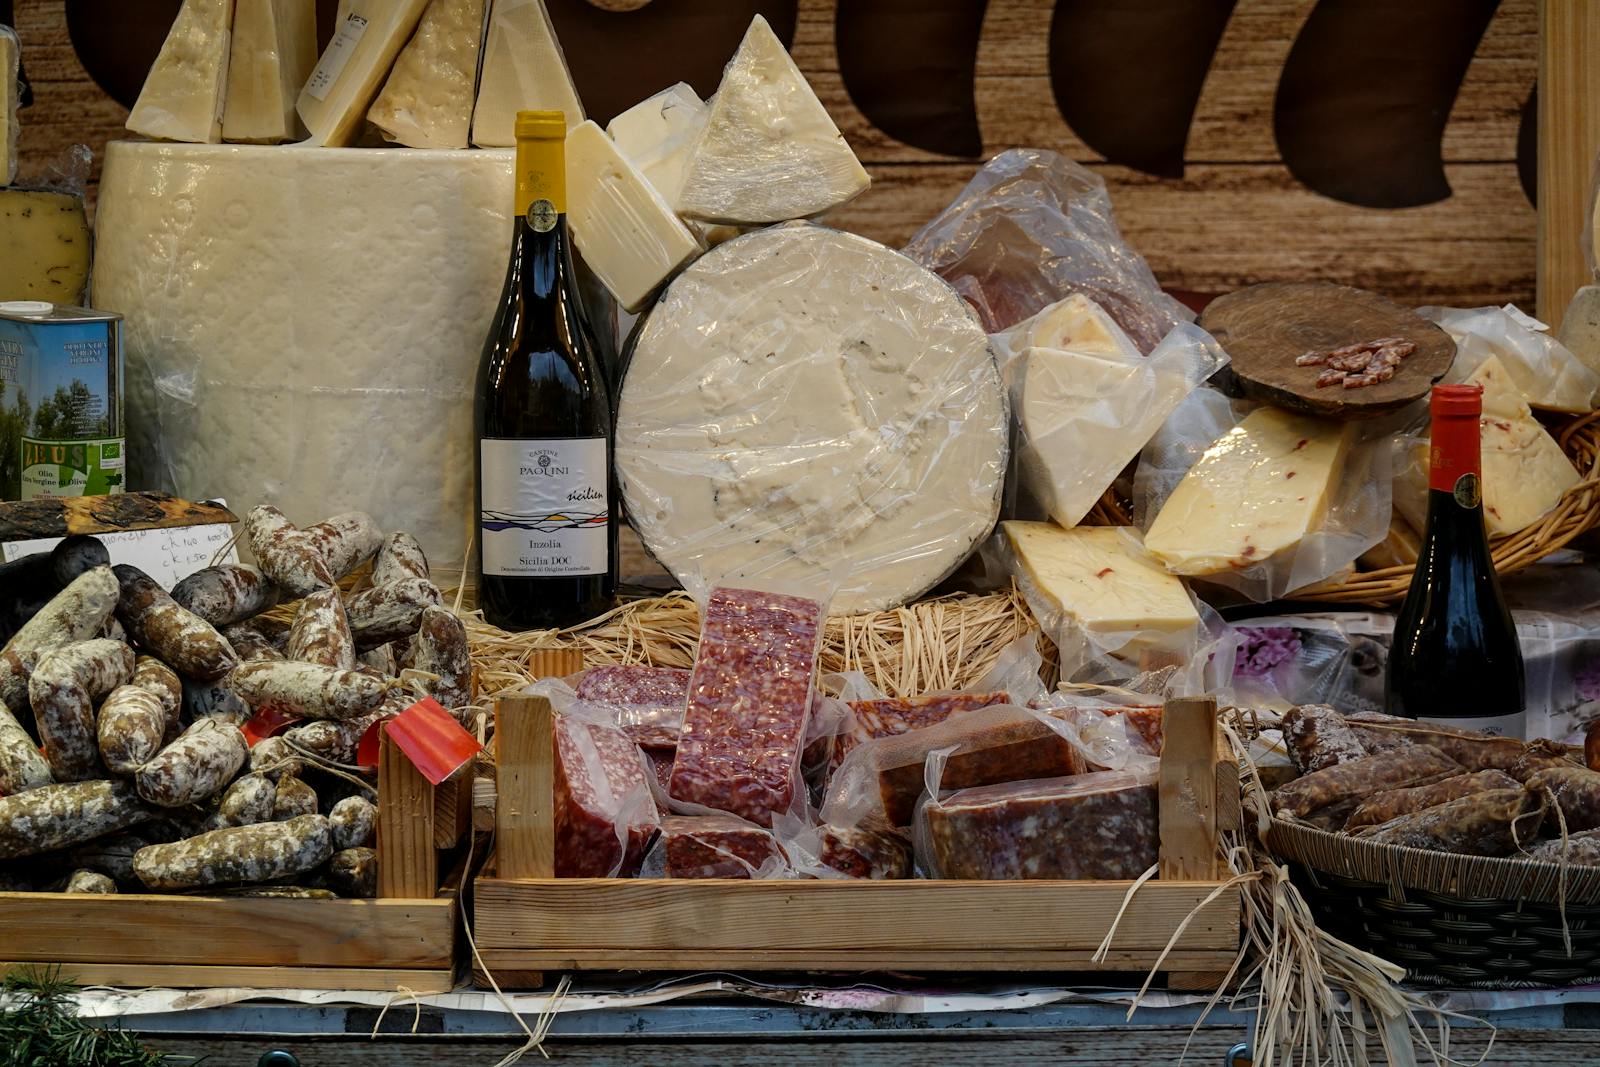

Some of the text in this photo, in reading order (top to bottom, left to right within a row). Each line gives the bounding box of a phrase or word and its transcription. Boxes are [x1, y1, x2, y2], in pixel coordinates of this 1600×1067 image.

[25, 444, 84, 468] ZEUS
[529, 449, 559, 458] CANTINE
[38, 470, 53, 478] Olio
[520, 466, 569, 477] PAOLINI
[68, 478, 87, 486] Oliva
[529, 539, 562, 549] Inzolia
[519, 556, 573, 566] Sicilia DOC
[544, 566, 563, 574] Origine
